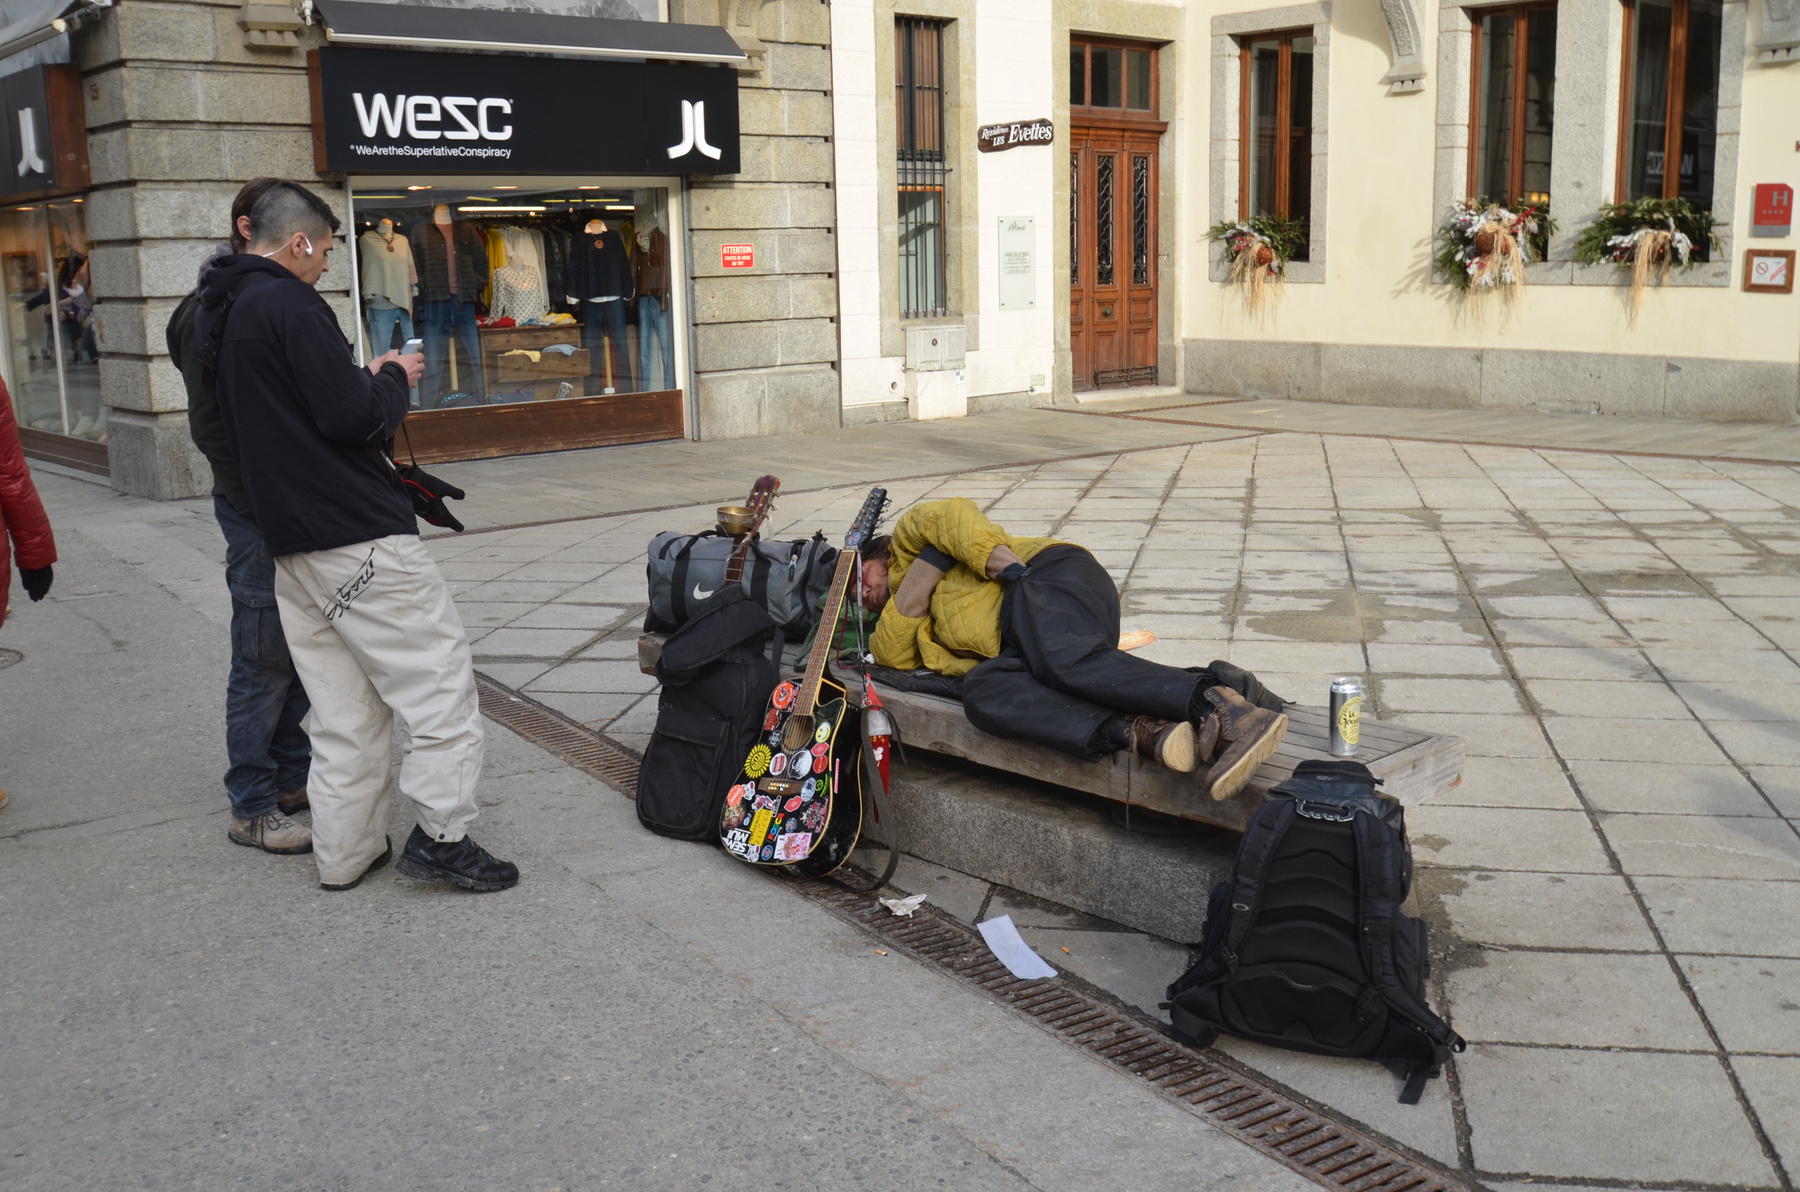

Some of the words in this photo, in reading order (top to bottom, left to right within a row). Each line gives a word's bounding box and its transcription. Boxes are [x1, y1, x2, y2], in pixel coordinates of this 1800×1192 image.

[1007, 122, 1053, 144] Evettes
[992, 136, 1005, 147] LES
[1772, 190, 1788, 206] H
[722, 246, 752, 254] ATTENTION
[767, 811, 785, 841] POSCA
